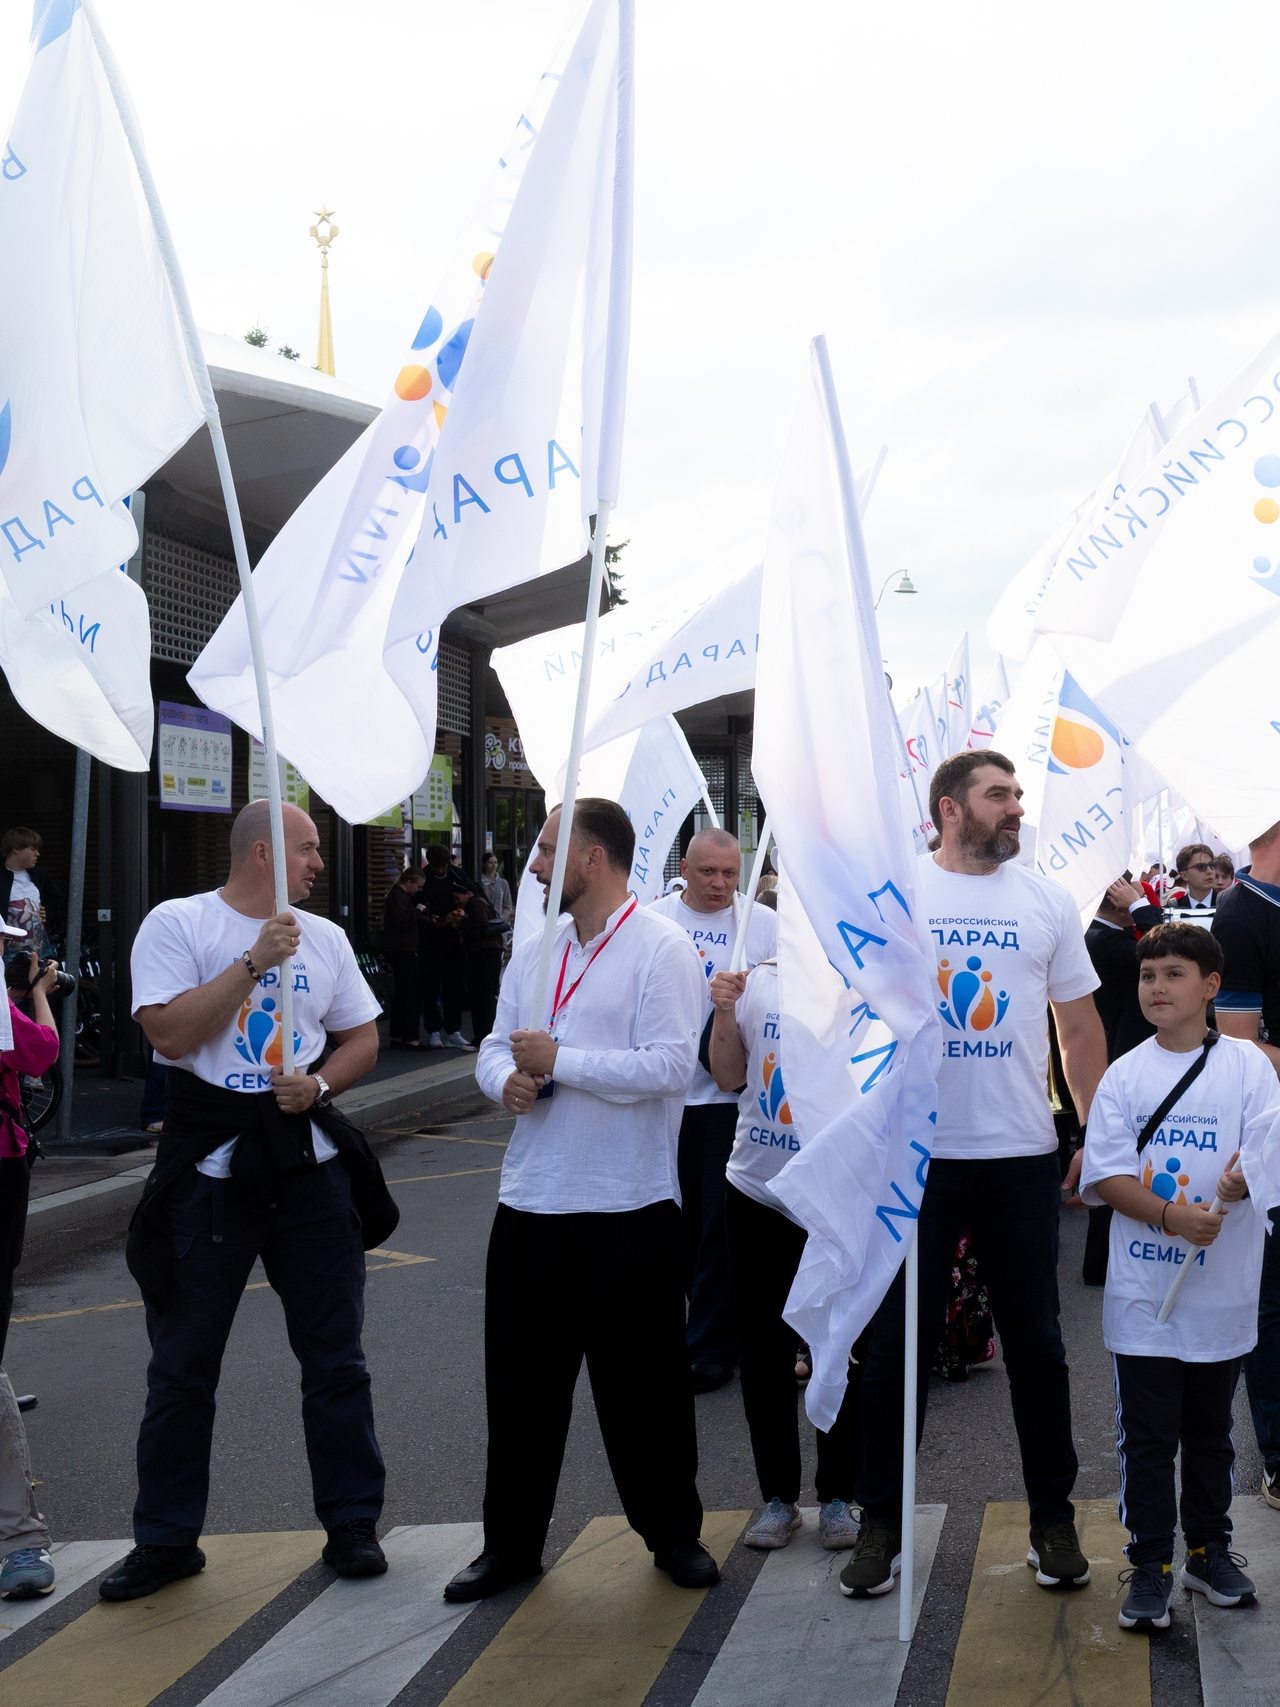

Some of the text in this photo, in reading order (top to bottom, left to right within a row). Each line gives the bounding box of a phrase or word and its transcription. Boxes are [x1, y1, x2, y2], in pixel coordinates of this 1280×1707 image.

[928, 918, 1019, 927] ВСЕРОССИЙСКИЙ
[224, 1073, 274, 1090] СЕМ
[749, 1126, 801, 1151] СЕМЬ
